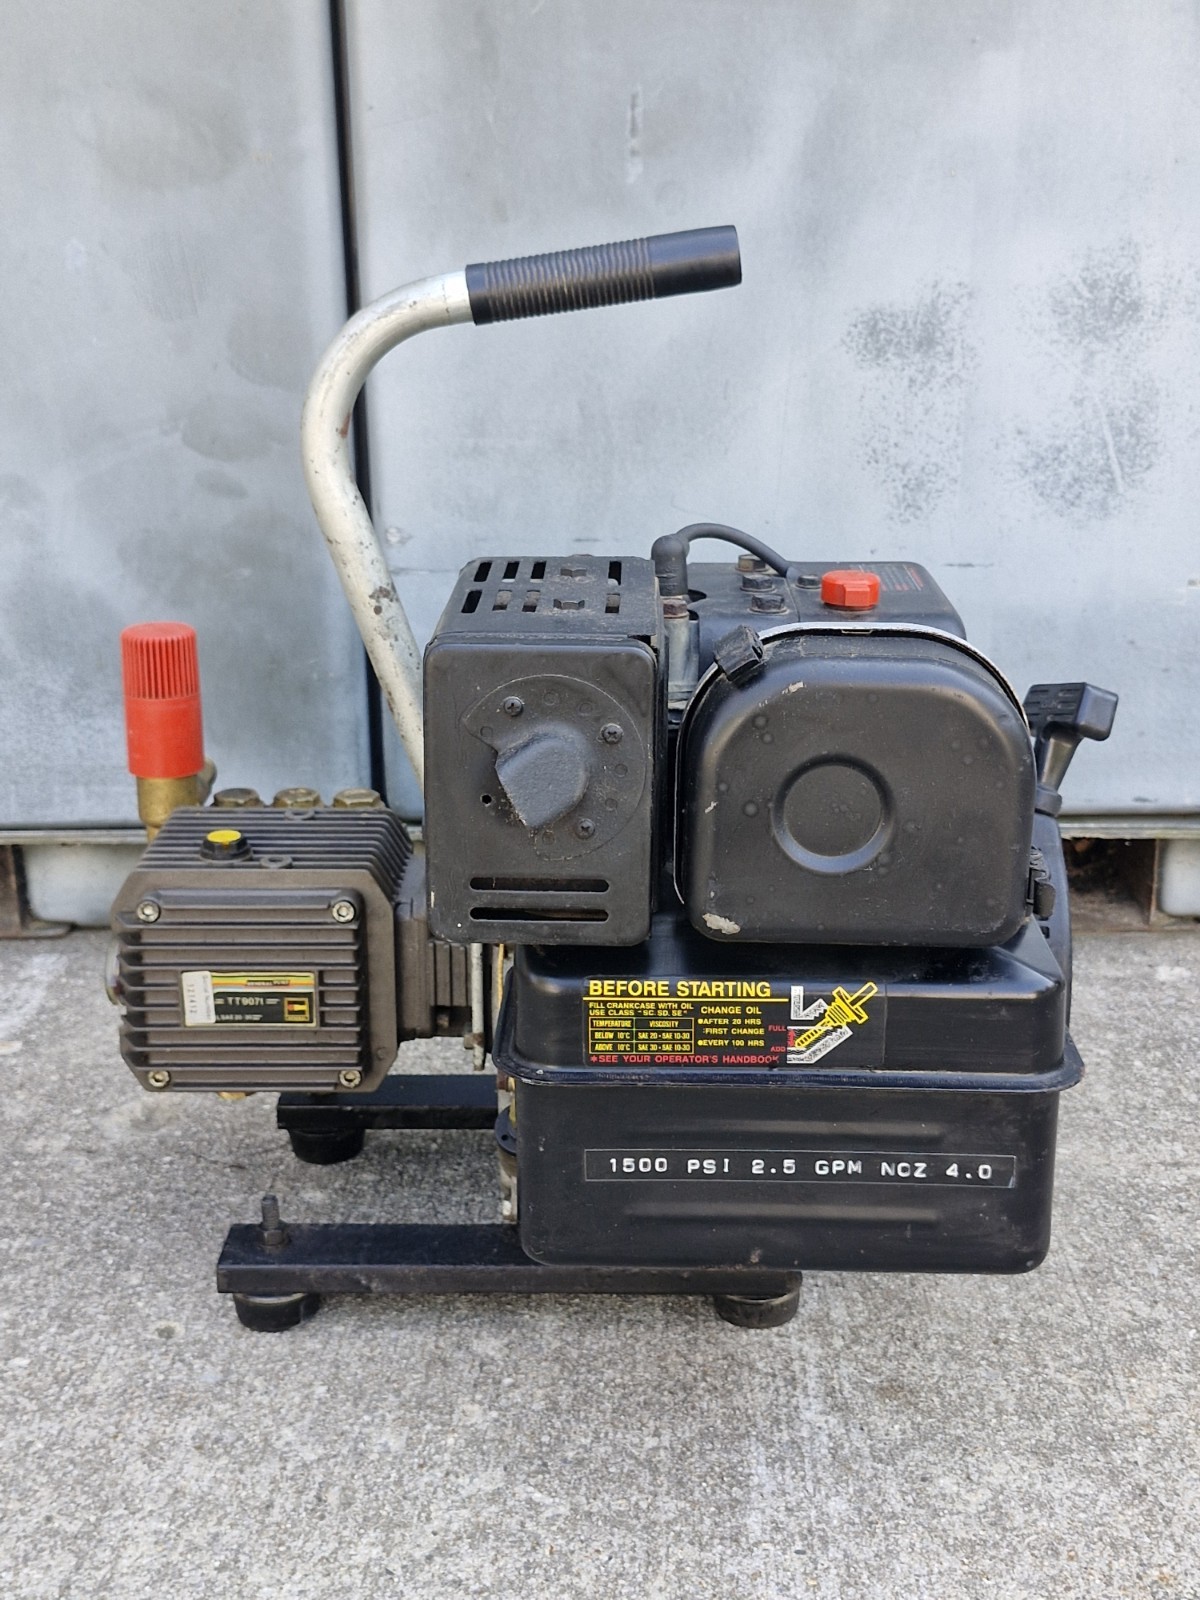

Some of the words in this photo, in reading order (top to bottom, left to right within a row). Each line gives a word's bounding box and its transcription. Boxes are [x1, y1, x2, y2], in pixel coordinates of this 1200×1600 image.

[589, 980, 670, 997] BEFORE
[676, 981, 771, 997] STARTING
[606, 1002, 656, 1010] CRANKCASE
[701, 1006, 741, 1014] CHANGE
[745, 1006, 762, 1014] OIL
[592, 1020, 632, 1028] TEMPERATURE
[648, 1020, 679, 1028] VISCOSITY
[622, 1055, 651, 1063] YOUR
[655, 1055, 718, 1063] OPERATOR'S
[609, 1157, 668, 1173] 1500
[687, 1158, 730, 1174] PSI
[751, 1159, 797, 1175] 2.5
[814, 1160, 863, 1176] GPM
[945, 1163, 992, 1180] 4.0
